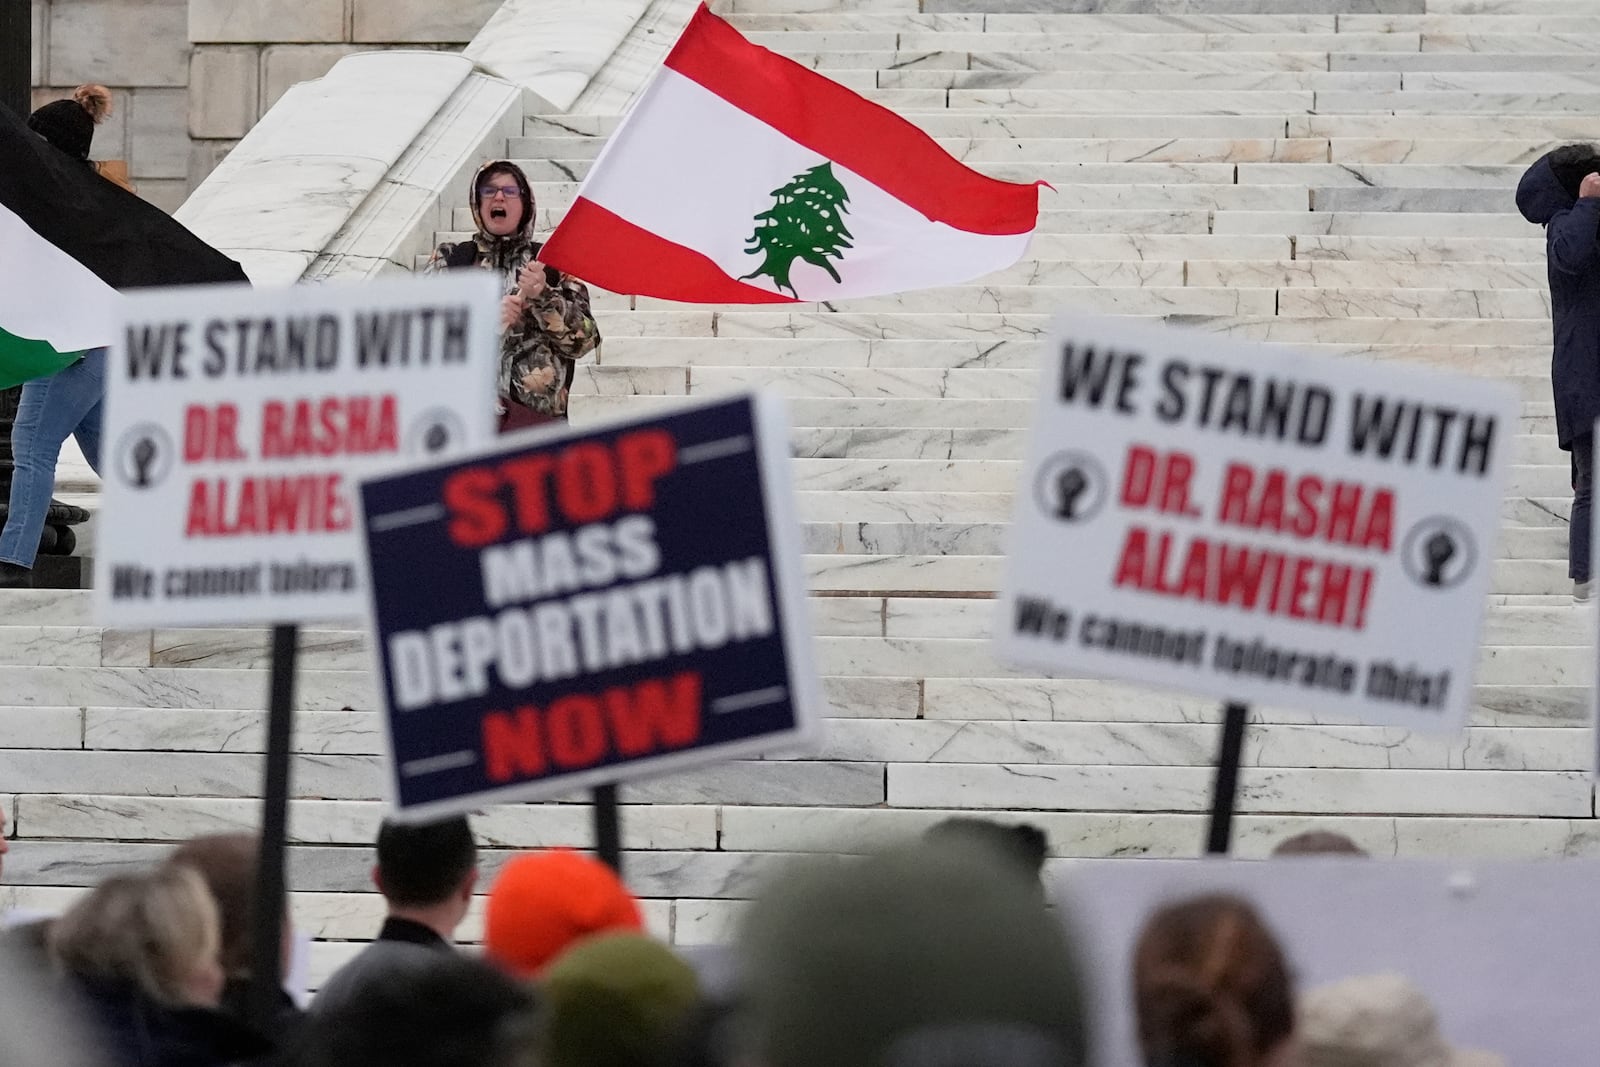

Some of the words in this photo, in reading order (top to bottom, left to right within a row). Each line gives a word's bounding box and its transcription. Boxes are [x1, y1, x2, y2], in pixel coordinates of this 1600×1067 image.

[126, 322, 189, 380] WE
[203, 313, 339, 378] STAND
[356, 304, 470, 369] WITH
[182, 403, 247, 463] DR.
[261, 394, 398, 460] RASHA
[1060, 341, 1144, 415] WE
[1154, 360, 1334, 447] STAND
[1349, 393, 1500, 477] WITH
[184, 475, 352, 538] ALAWIE
[443, 429, 678, 547] STOP
[1118, 444, 1201, 516] DR.
[1218, 462, 1395, 552] RASHA
[112, 561, 154, 600] We
[164, 561, 261, 599] cannot
[269, 559, 355, 596] tolera
[480, 514, 661, 607] MASS
[1112, 527, 1376, 630] ALAWIEH!
[389, 556, 774, 711] DEPORTATION
[1013, 596, 1069, 642] We
[1078, 613, 1205, 665] cannot
[1366, 661, 1451, 711] this!
[481, 671, 702, 782] NOW
